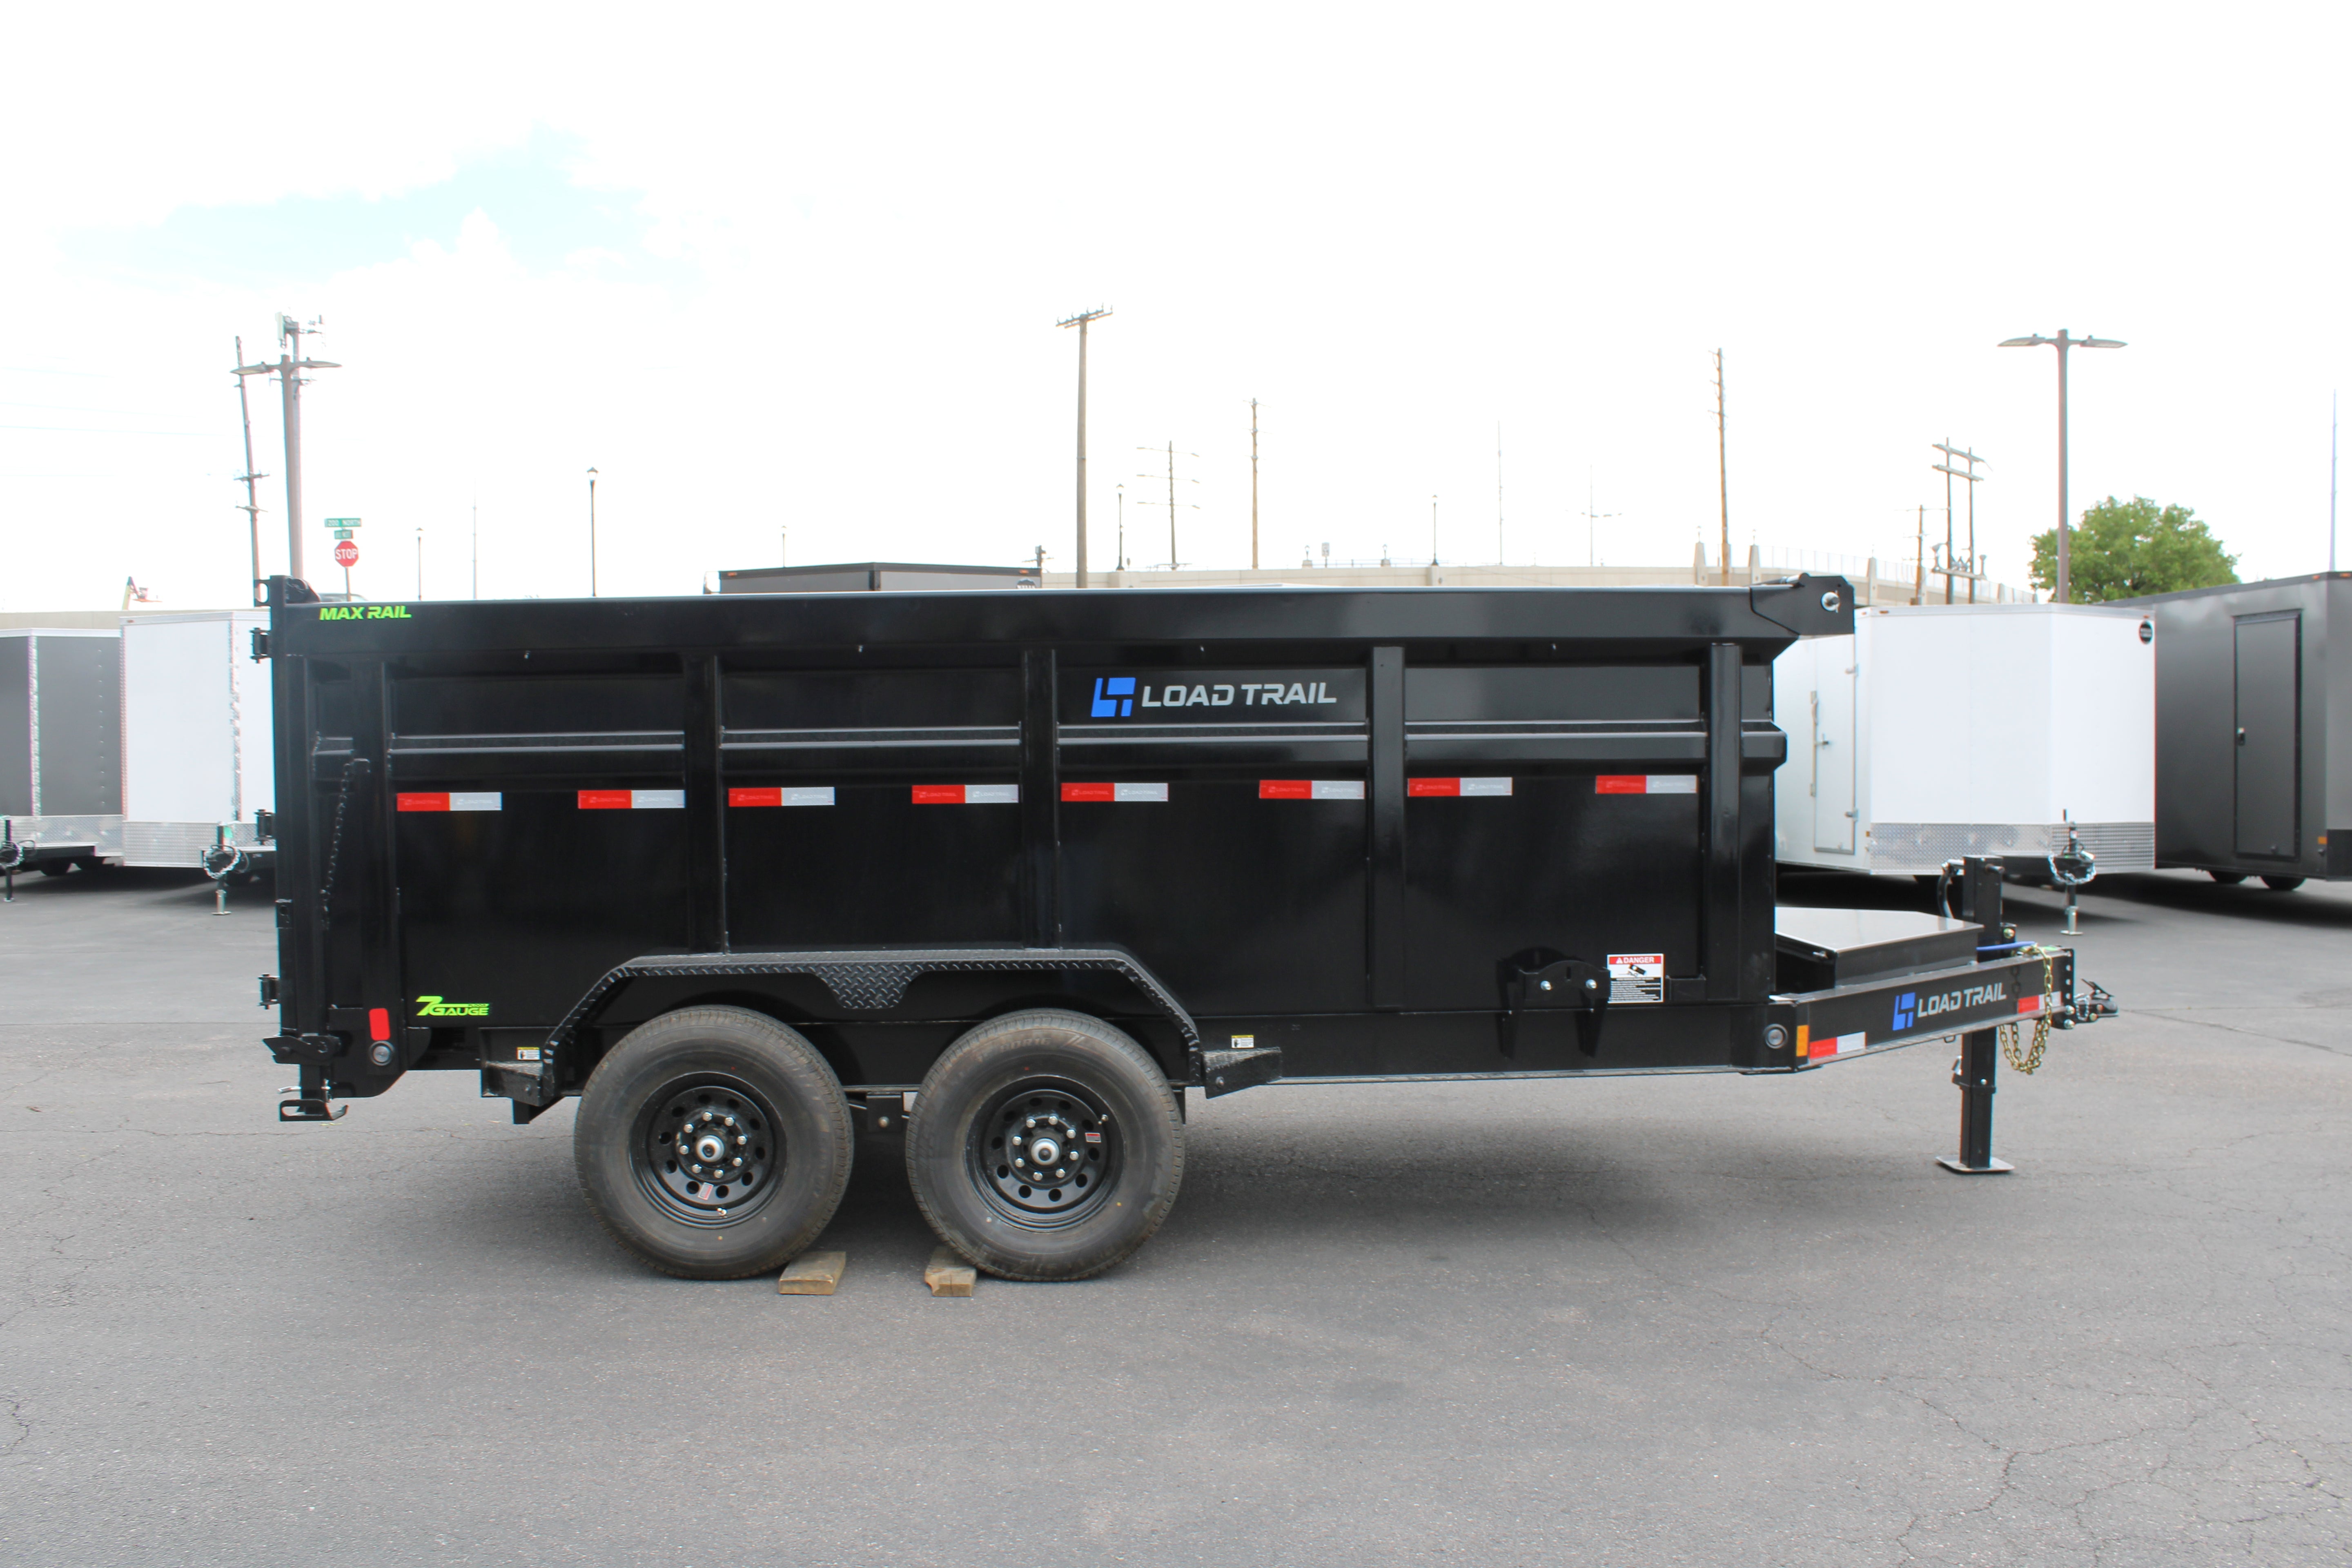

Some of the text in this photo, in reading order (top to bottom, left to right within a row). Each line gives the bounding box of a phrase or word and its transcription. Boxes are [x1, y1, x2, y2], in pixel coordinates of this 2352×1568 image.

[335, 548, 357, 560] STOP
[319, 606, 412, 621] MAX RAIL
[1142, 682, 1337, 707] LOAD TRAIL
[1918, 982, 2007, 1018] LOAD TRAIL
